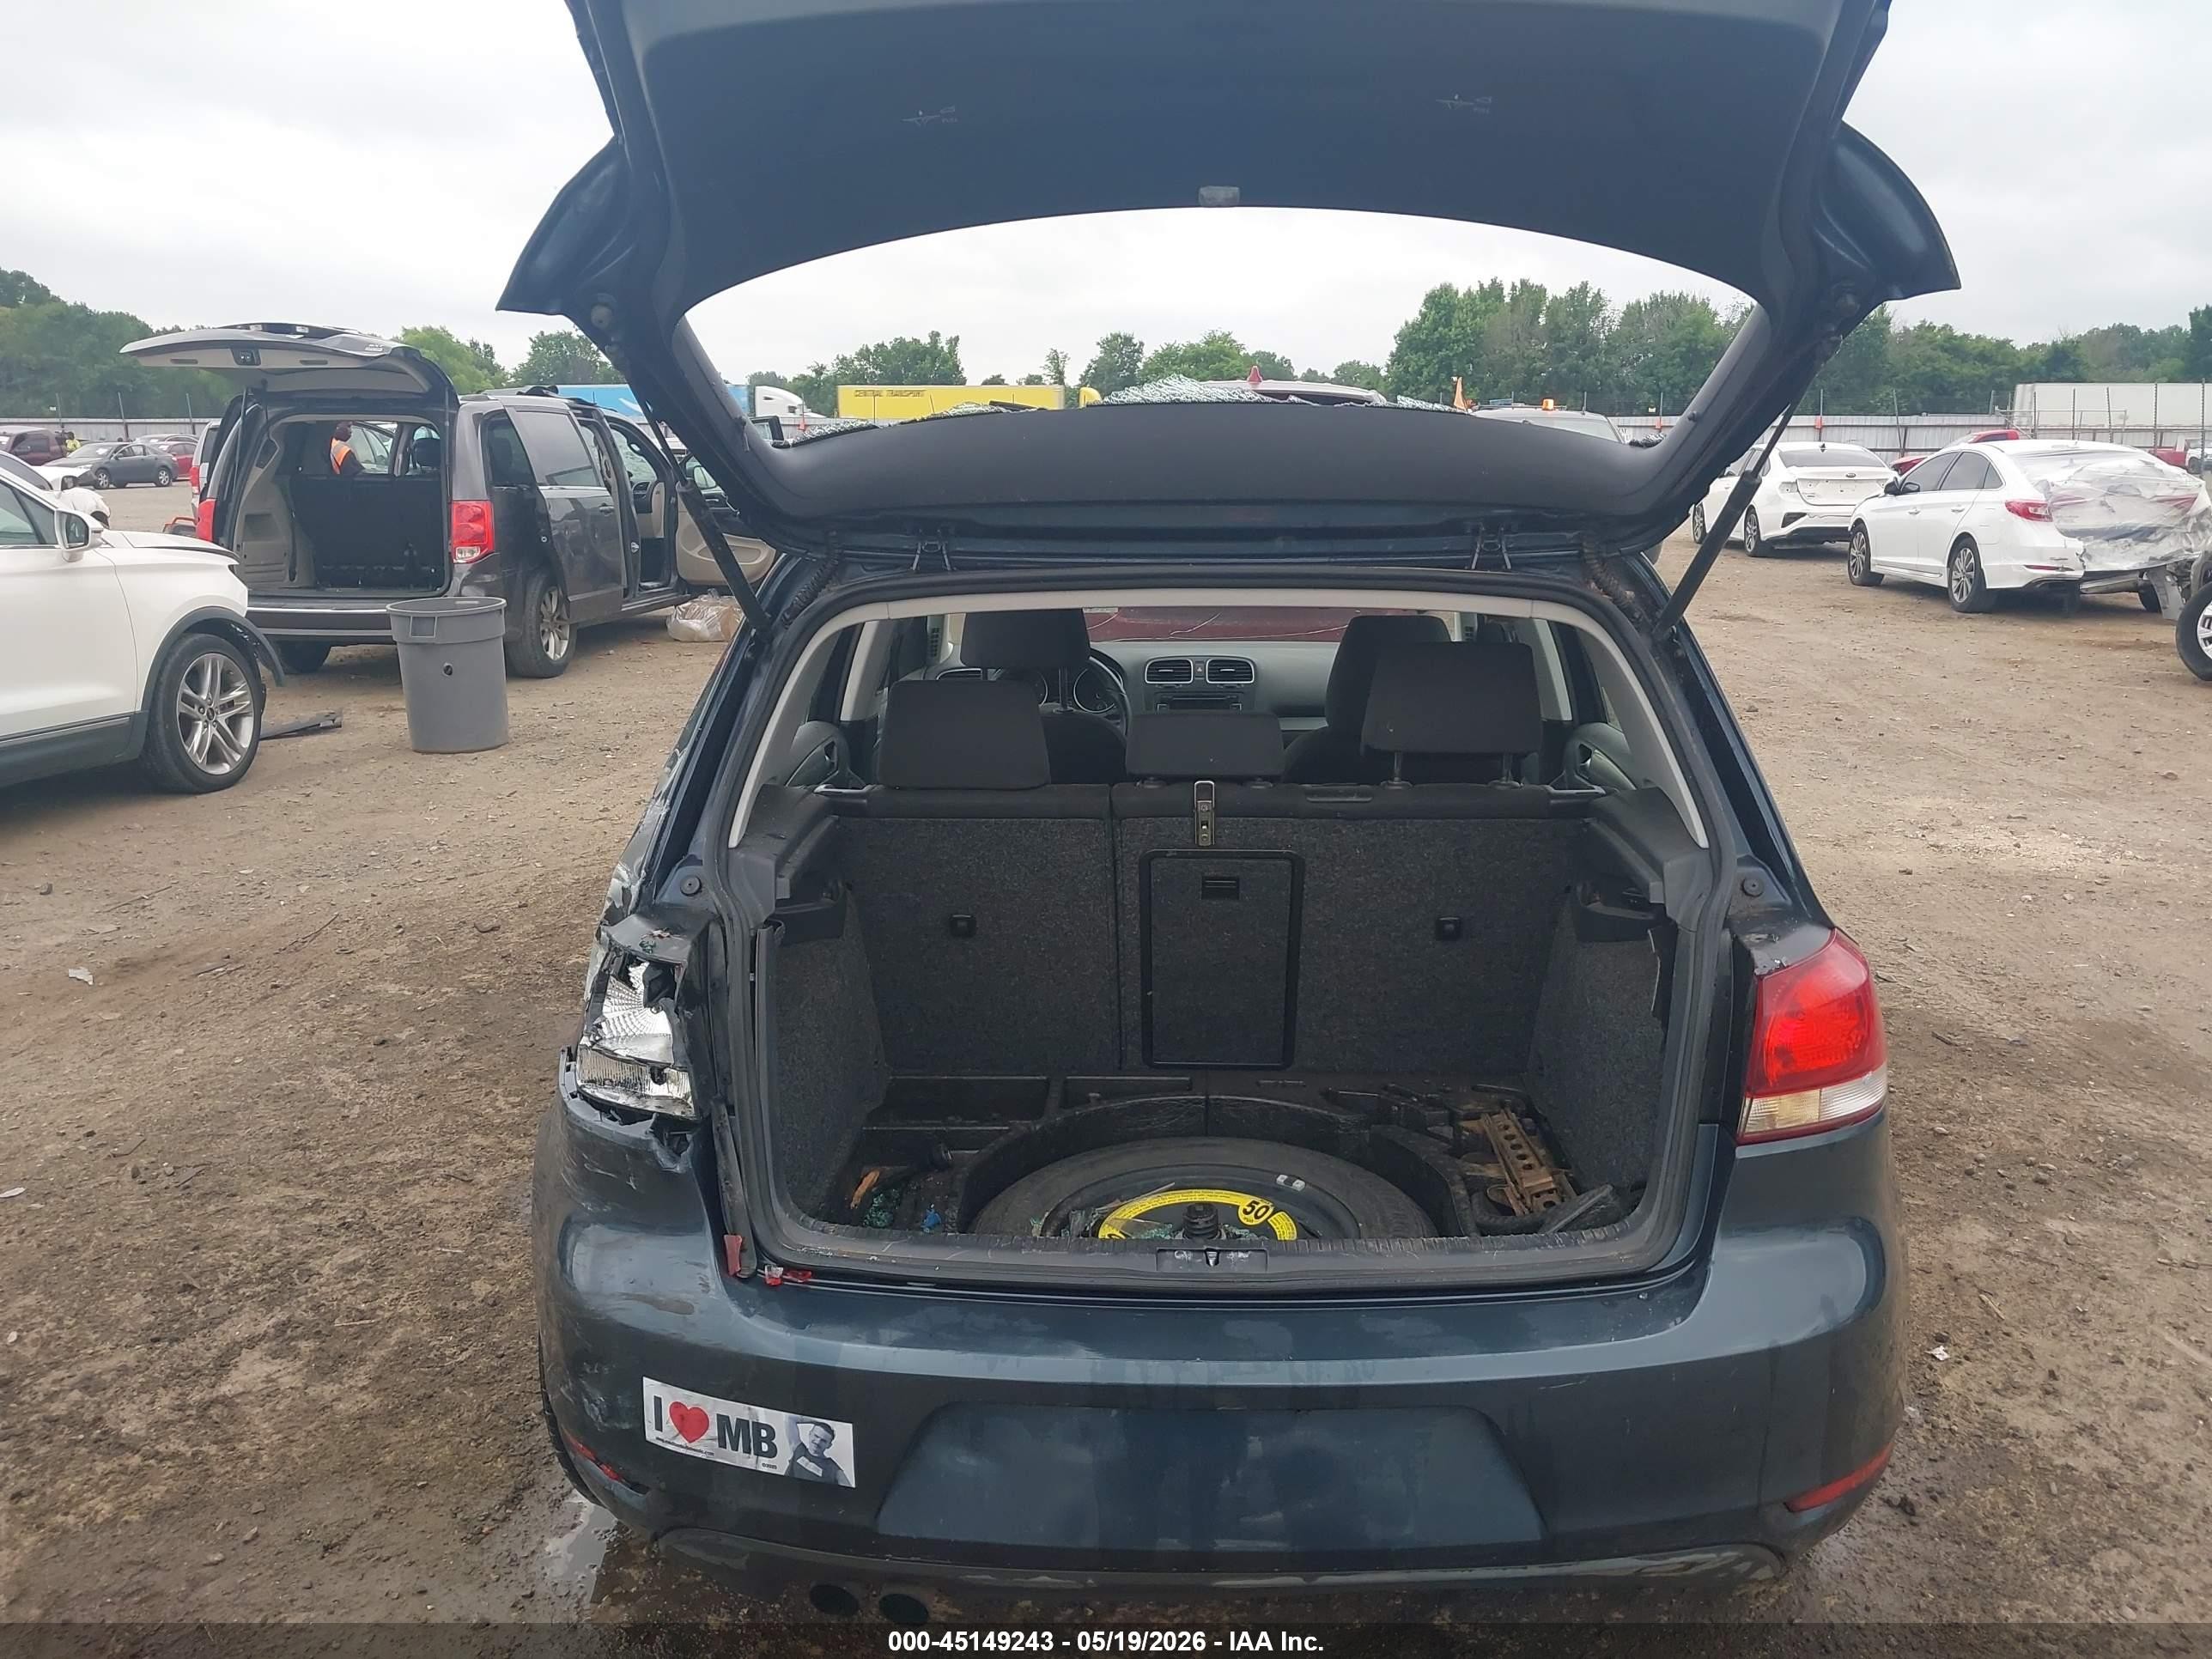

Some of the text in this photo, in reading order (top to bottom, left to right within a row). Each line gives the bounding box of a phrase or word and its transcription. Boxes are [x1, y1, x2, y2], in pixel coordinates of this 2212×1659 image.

[1243, 1200, 1269, 1219] 50
[653, 1395, 663, 1432] I
[716, 1413, 778, 1459] MB
